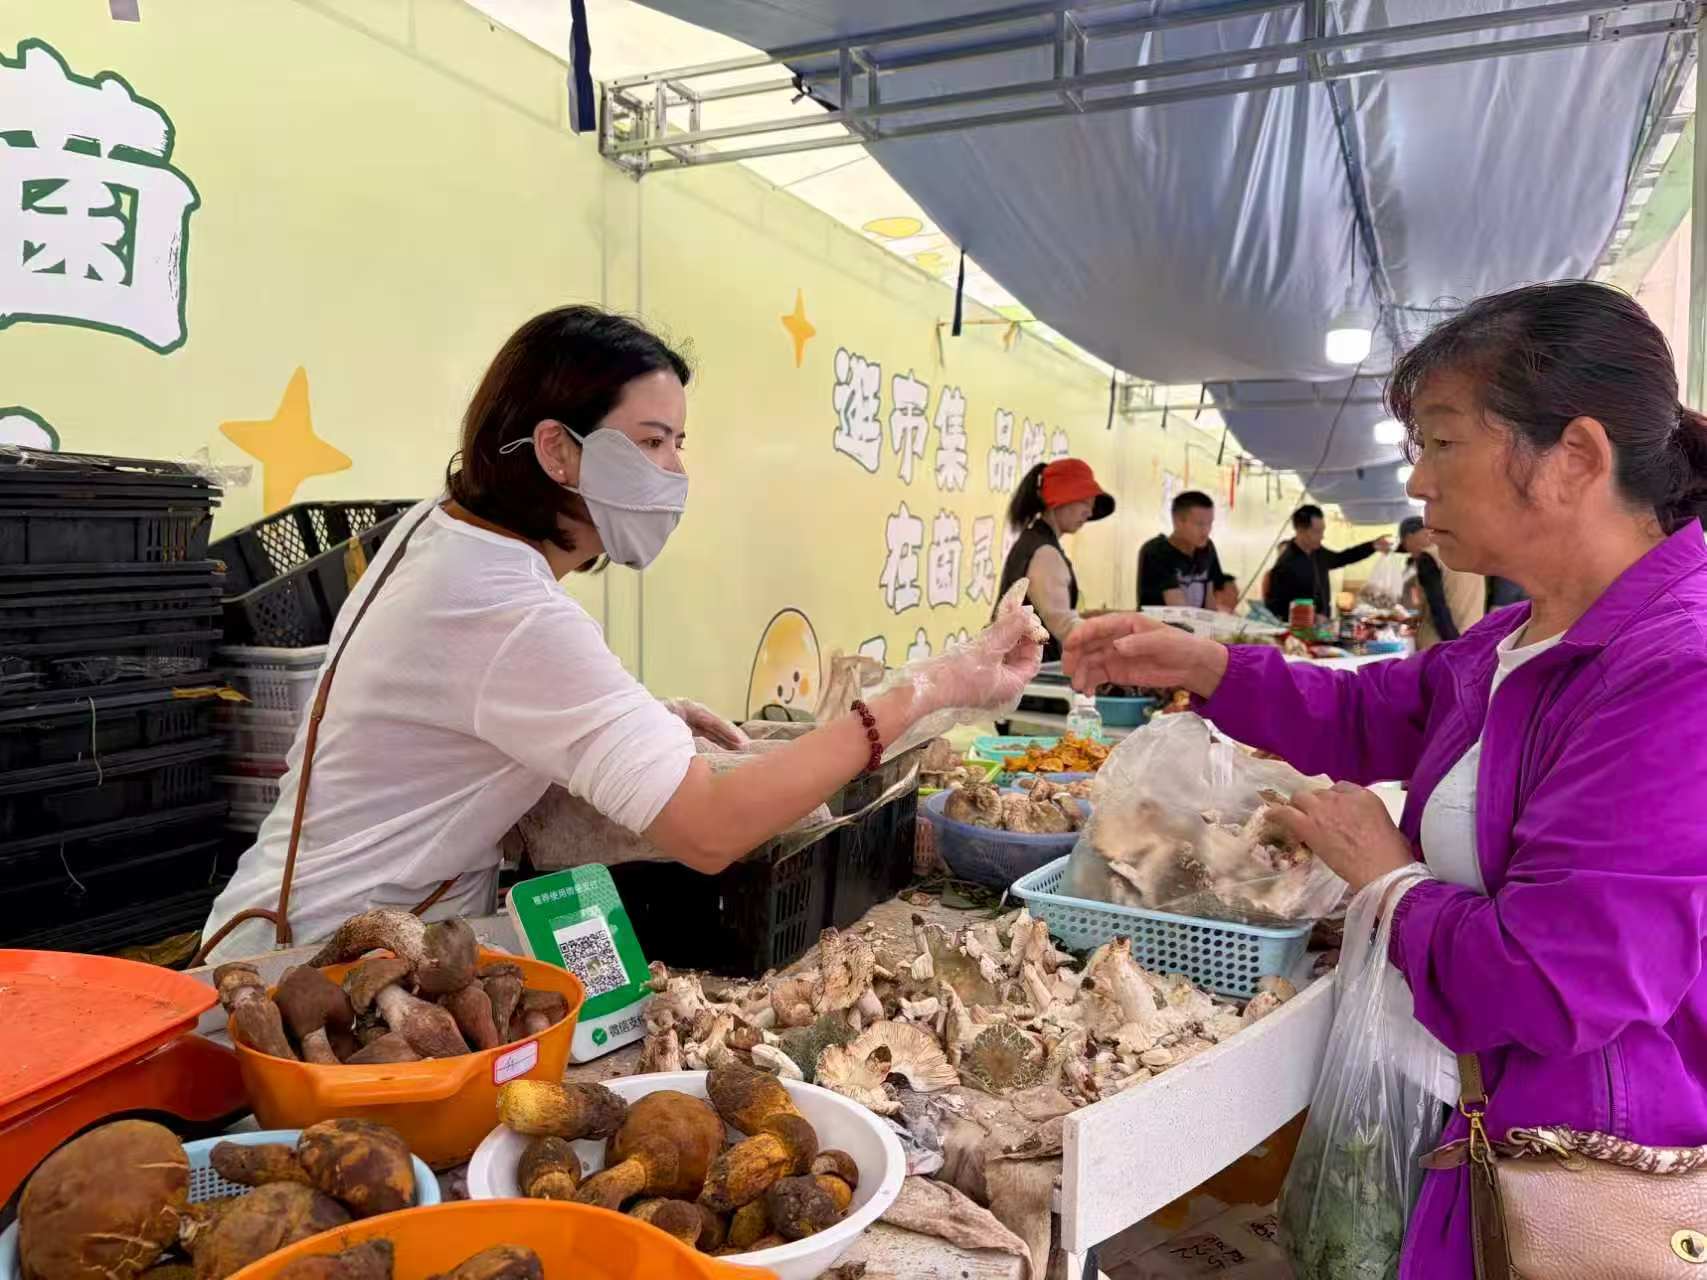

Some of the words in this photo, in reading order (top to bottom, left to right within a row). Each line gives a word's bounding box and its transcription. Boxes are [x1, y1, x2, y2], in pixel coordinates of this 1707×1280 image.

[0, 37, 201, 354] 菌
[833, 347, 968, 491] 逛市集
[880, 501, 1020, 613] 在菌灵
